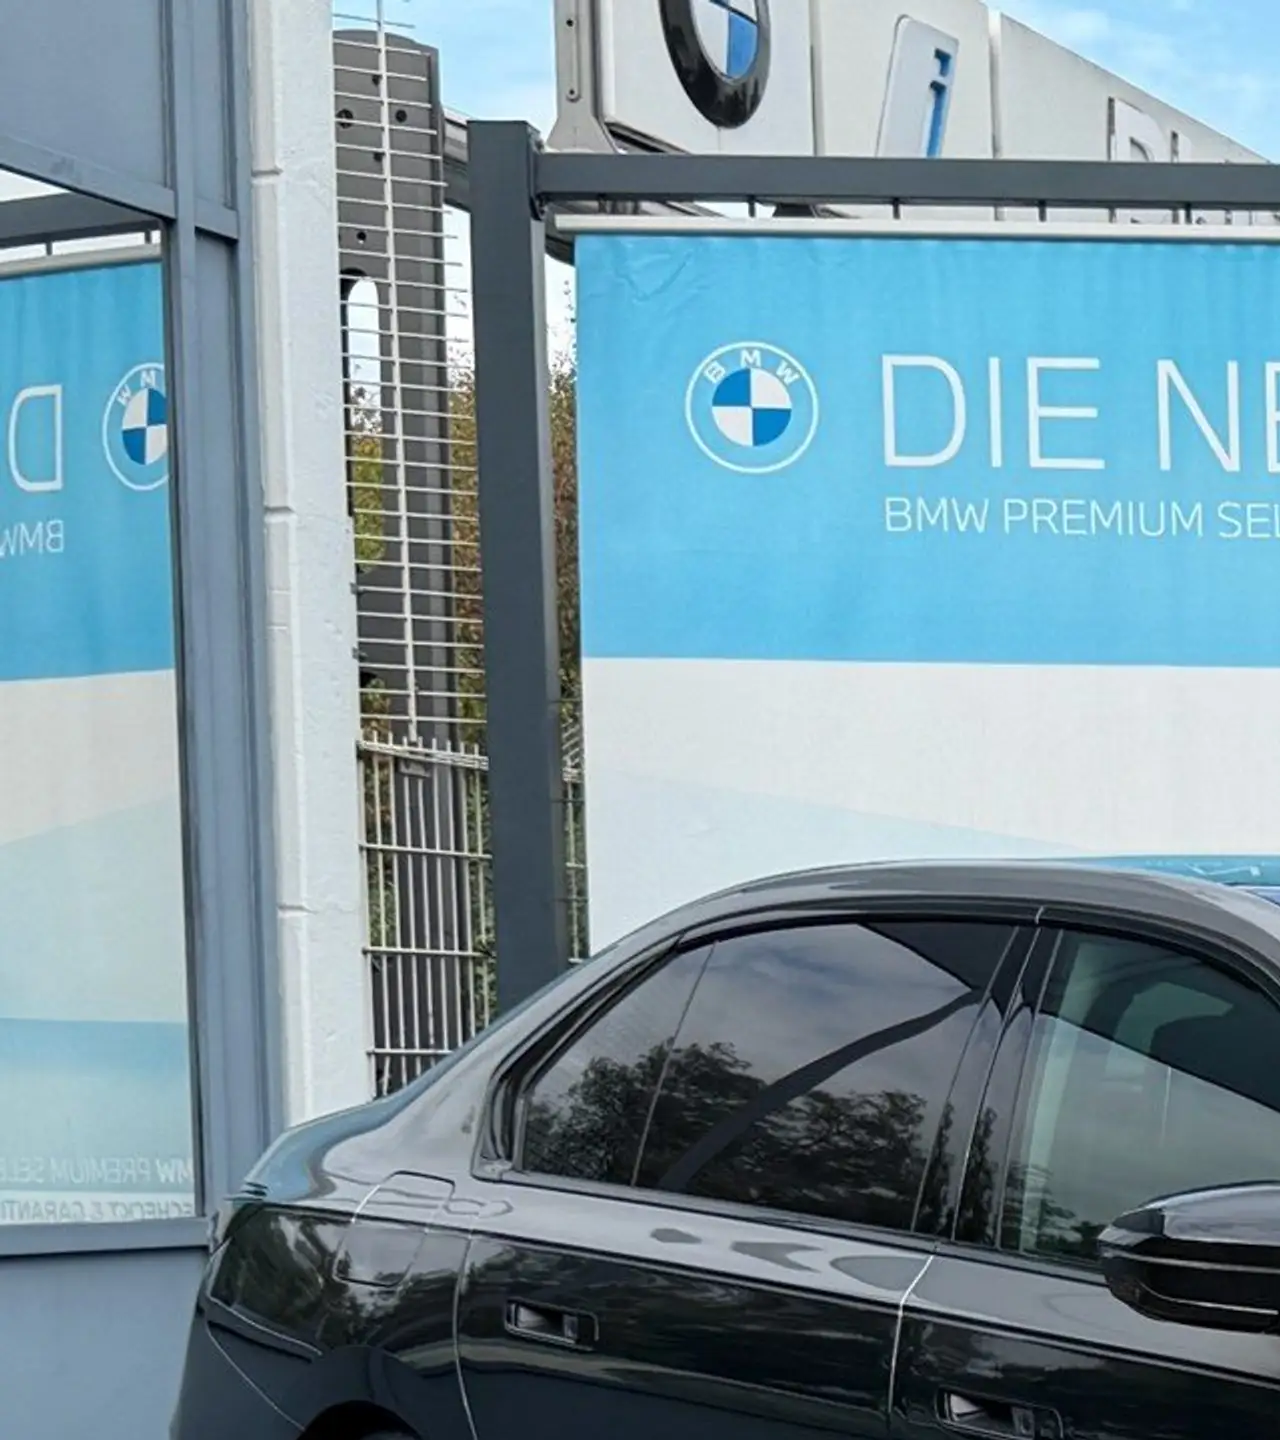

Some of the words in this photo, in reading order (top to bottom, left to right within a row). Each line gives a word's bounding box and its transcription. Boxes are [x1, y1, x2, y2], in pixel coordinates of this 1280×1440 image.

[703, 348, 800, 386] BMW
[880, 354, 1105, 470] DIE
[885, 496, 989, 534] BMW
[1003, 498, 1203, 537] PREMIUM
